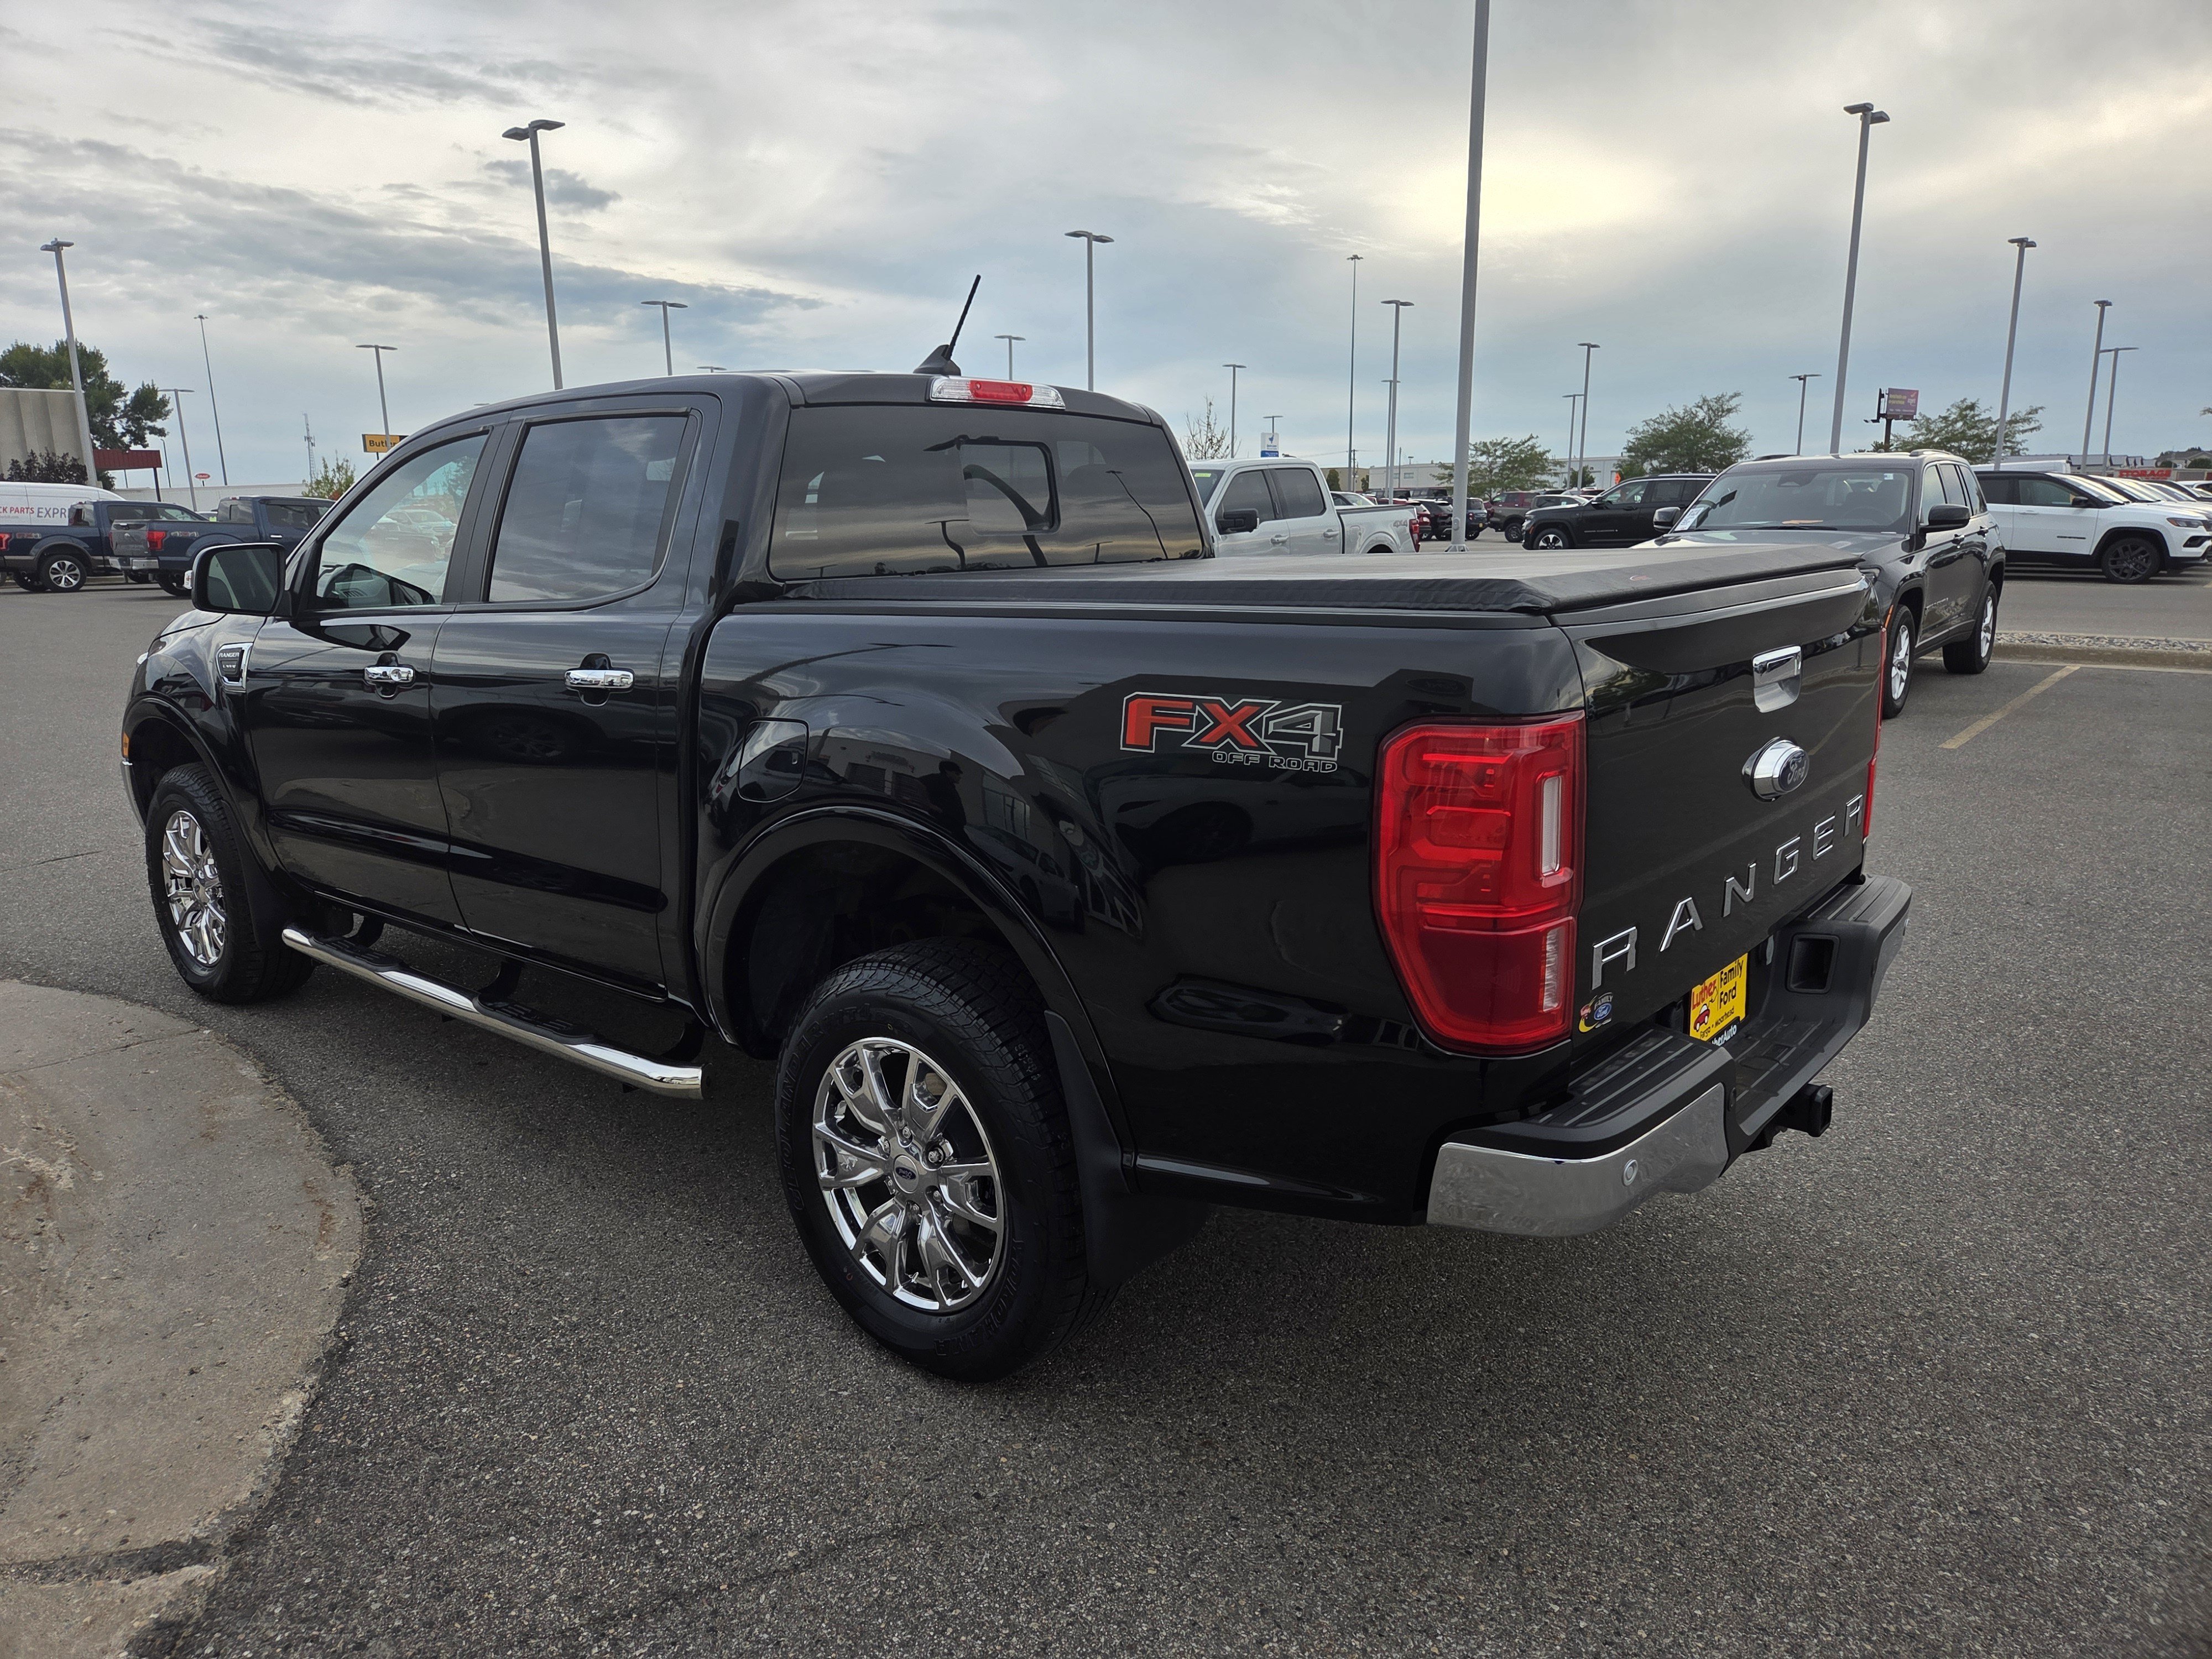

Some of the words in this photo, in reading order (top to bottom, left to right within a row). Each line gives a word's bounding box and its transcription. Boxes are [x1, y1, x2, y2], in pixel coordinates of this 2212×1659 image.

[36, 507, 67, 518] EXPR
[1120, 691, 1343, 761] FX4
[1212, 751, 1260, 766] OFF
[1269, 757, 1338, 773] ROAD
[1786, 751, 1807, 786] Ford
[1592, 794, 1864, 991] RANGER
[1720, 959, 1744, 989] Family
[1692, 979, 1717, 1010] Luther
[1720, 981, 1737, 1010] Ford
[1714, 1005, 1735, 1029] Moorhead
[898, 1168, 913, 1180] Ford
